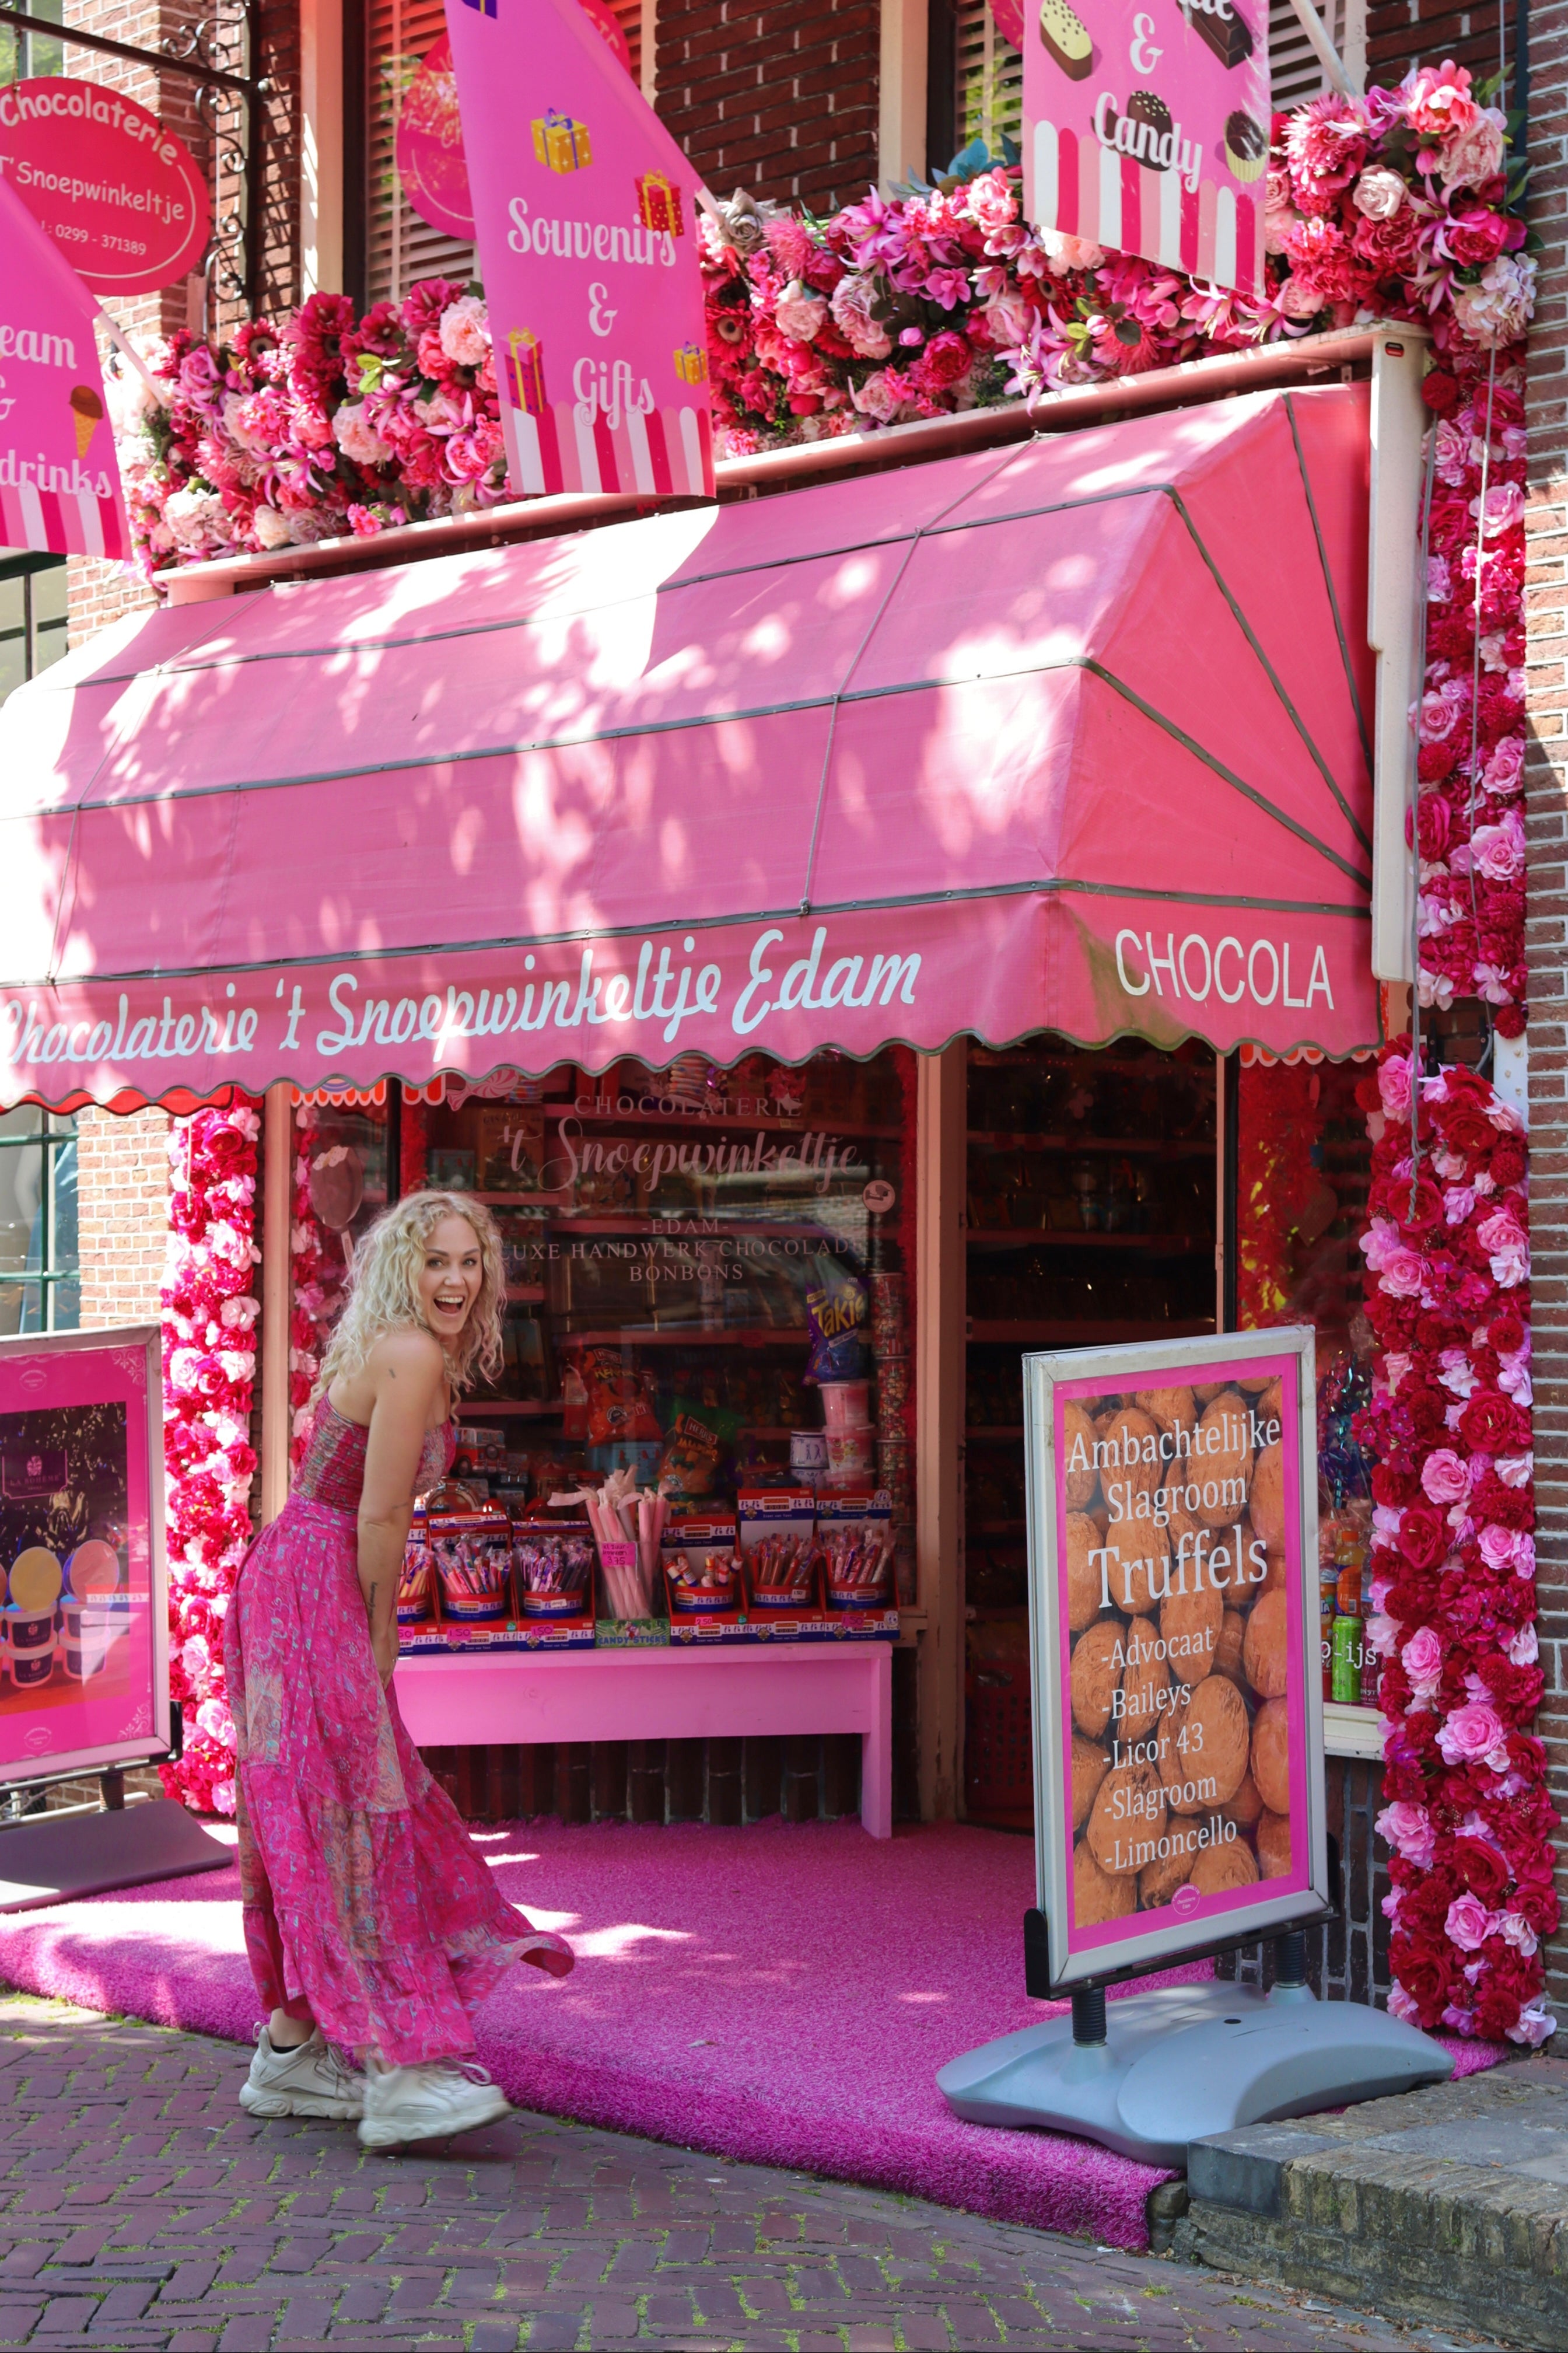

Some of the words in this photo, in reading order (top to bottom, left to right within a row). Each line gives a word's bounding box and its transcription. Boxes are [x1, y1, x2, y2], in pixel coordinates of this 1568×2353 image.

[1130, 12, 1164, 74] &
[0, 87, 177, 166] Chocolaterie
[1094, 92, 1202, 194] Candy
[16, 162, 185, 224] Snoepwinkeltje
[55, 223, 89, 243] 0299
[101, 234, 147, 256] 371389
[508, 197, 676, 267] Souvenirs
[588, 282, 618, 337] &
[573, 357, 654, 431] Gifts
[276, 978, 306, 1051] 't
[316, 936, 722, 1063] Snoepwinkeltje
[732, 926, 922, 1034] Edam
[1115, 929, 1334, 1010] CHOCOLA
[574, 1095, 802, 1118] CHOCOLATERIE
[537, 1116, 863, 1193] Snoepwinkeltje
[571, 1240, 708, 1260] HANDWERK
[629, 1264, 743, 1282] BONBONS
[1068, 1409, 1280, 1473] Ambachtelijke
[1108, 1477, 1248, 1527] Slagroom
[1088, 1524, 1268, 1609] Truffels
[597, 1637, 630, 1645] CANDY
[633, 1635, 667, 1644] STICKS
[1101, 1625, 1214, 1670] -Advocaat
[1102, 1682, 1191, 1721] -Baileys
[1103, 1733, 1170, 1771] -Licor
[1176, 1722, 1204, 1755] 43
[1105, 1775, 1217, 1820] -Slagroom
[1105, 1814, 1237, 1870] -Limoncello
